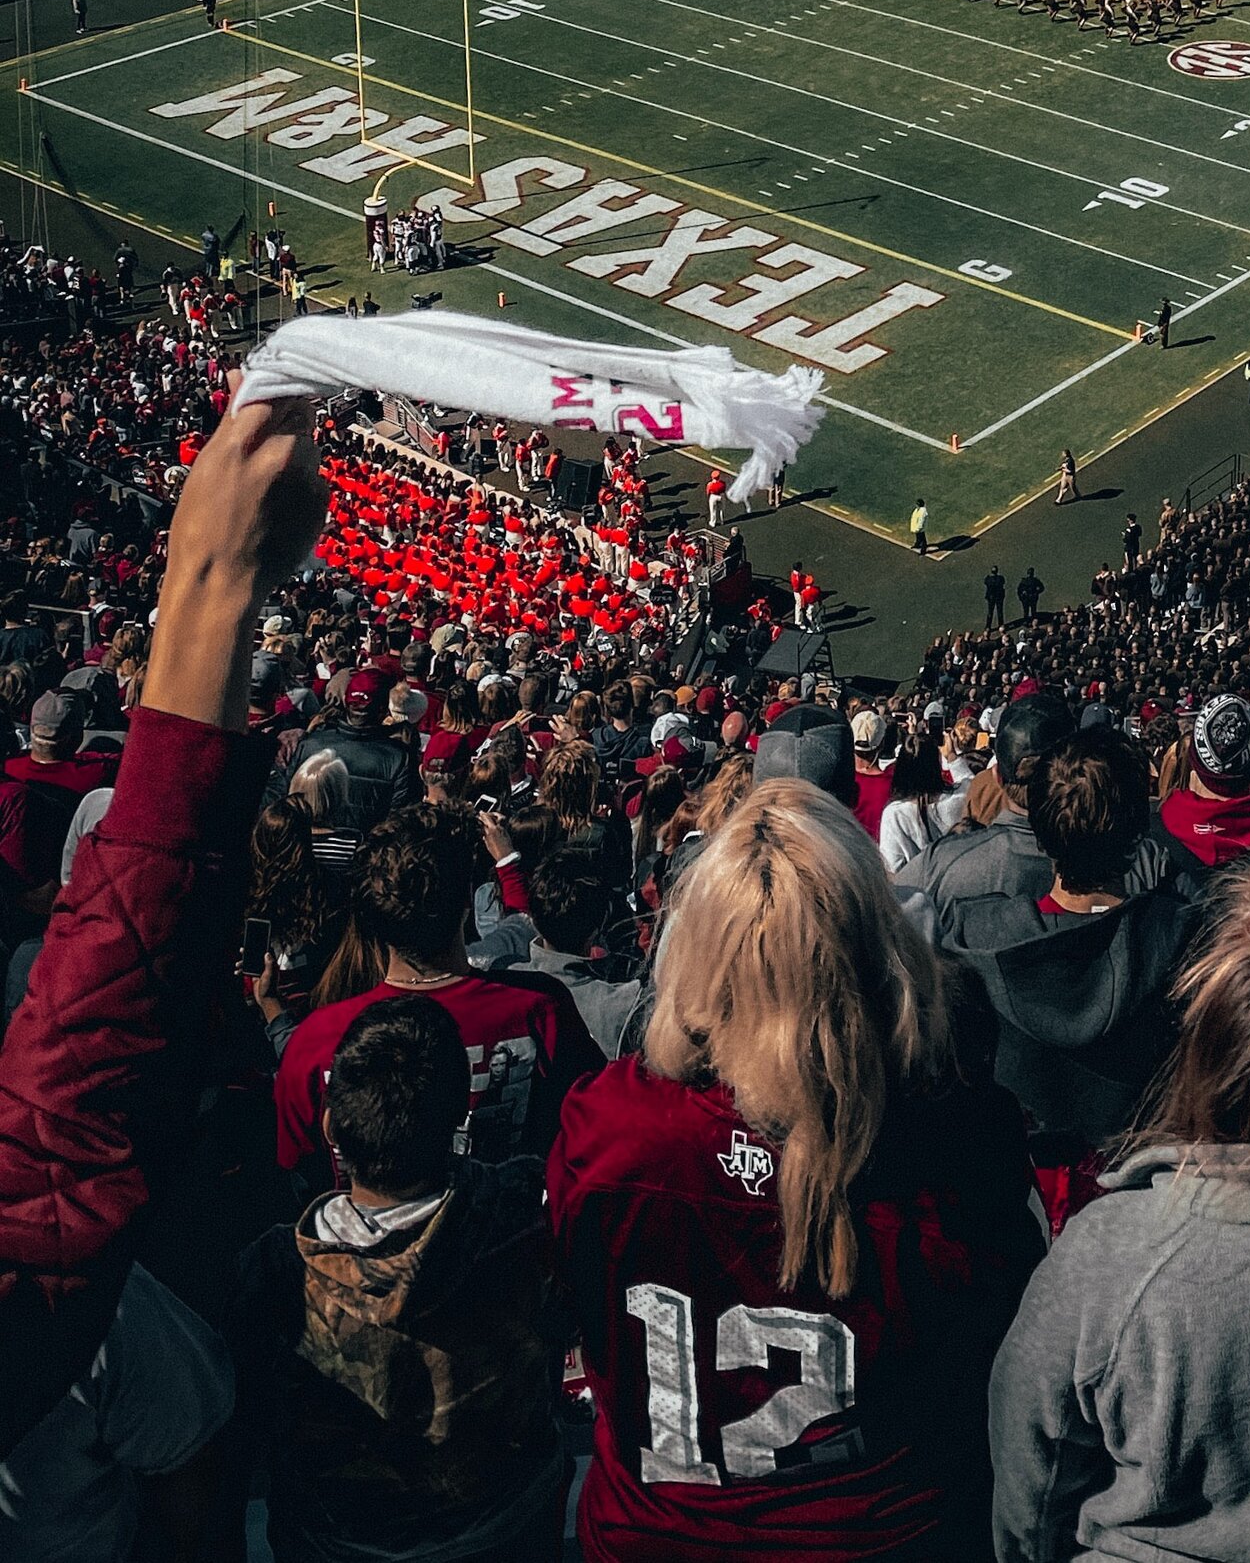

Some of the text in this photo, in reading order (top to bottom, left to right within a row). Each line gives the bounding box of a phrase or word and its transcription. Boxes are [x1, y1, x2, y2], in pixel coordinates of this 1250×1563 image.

[147, 66, 947, 374] TEXAS A&M
[1097, 177, 1170, 209] 10
[957, 259, 1013, 283] G
[625, 1283, 864, 1487] 12
